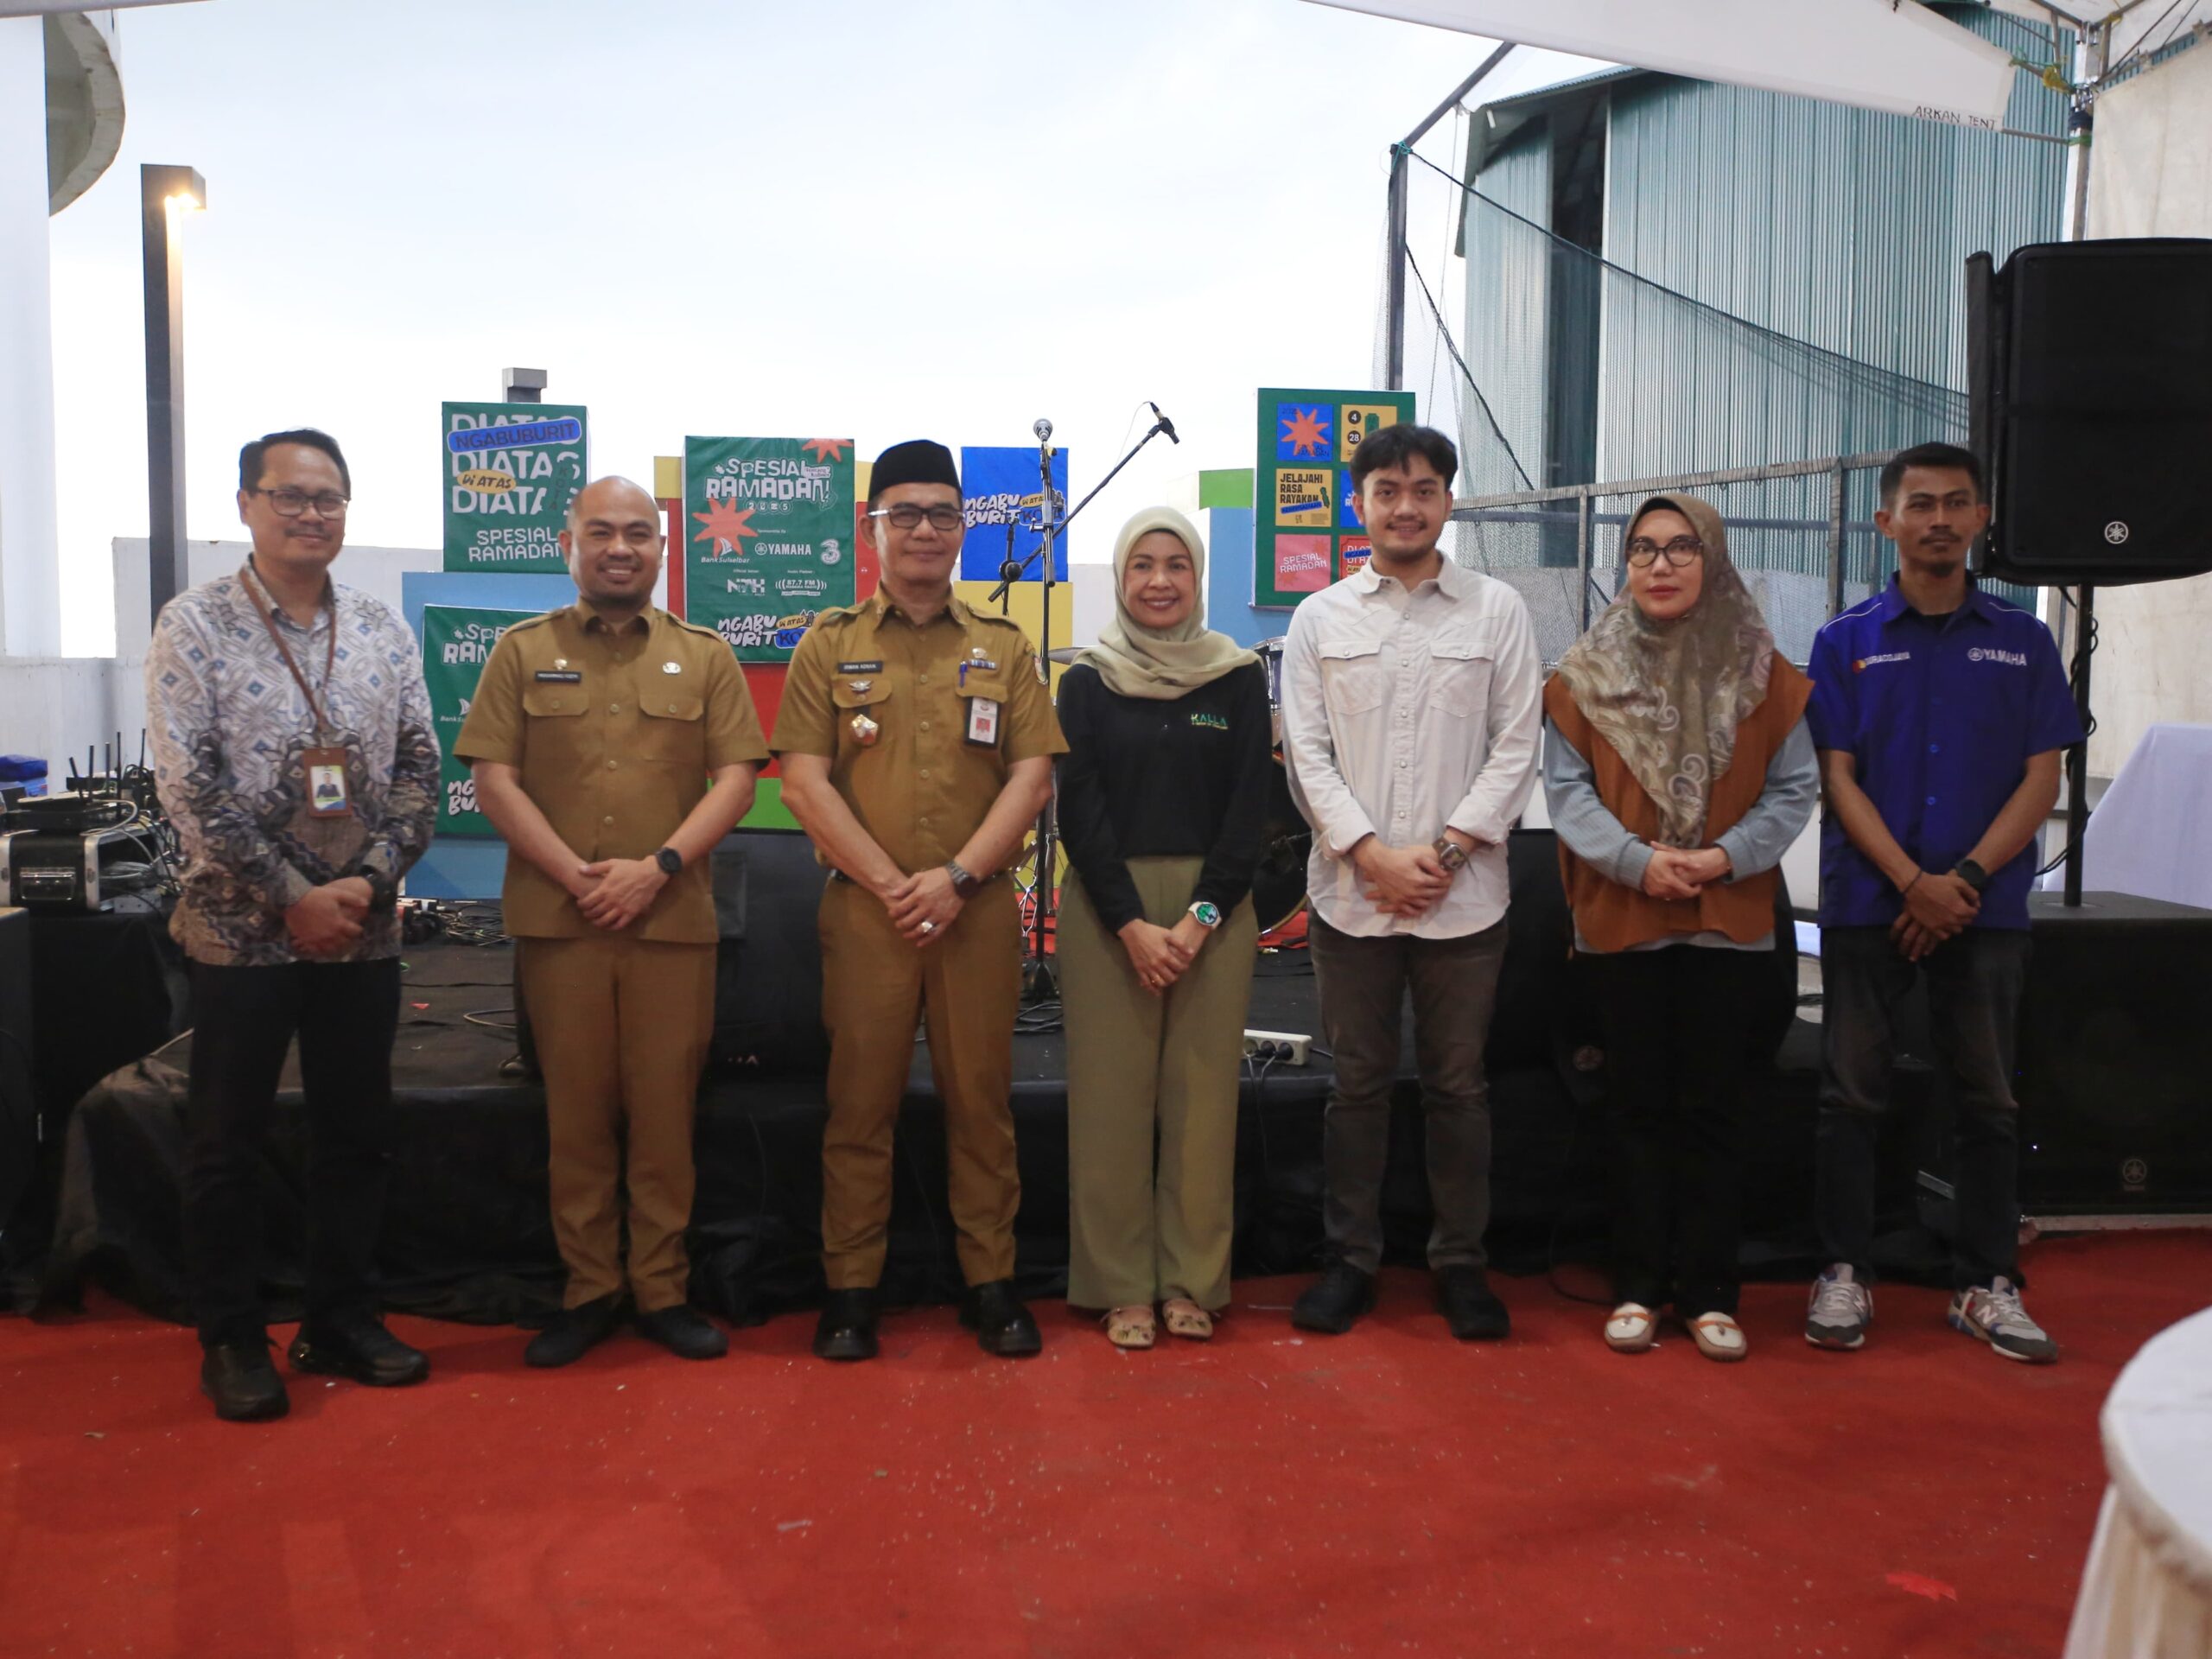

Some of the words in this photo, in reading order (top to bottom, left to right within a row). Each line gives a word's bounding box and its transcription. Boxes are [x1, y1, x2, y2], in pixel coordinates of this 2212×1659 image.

[1912, 105, 1961, 124] ARKAN
[1968, 115, 1997, 130] TENT
[454, 423, 575, 449] NGABUBURIT
[726, 458, 806, 478] SPESIAL
[477, 477, 512, 489] ATAS
[1281, 473, 1323, 483] JELAJAHI
[1281, 484, 1303, 493] RASA
[1281, 494, 1319, 504] RAYAKAN
[476, 526, 558, 545] SPESIAL
[768, 543, 811, 555] YAMAHA
[821, 538, 840, 564] 3
[1283, 552, 1322, 564] SPESIAL
[1280, 559, 1327, 573] RAMADAN
[465, 624, 508, 644] SPE
[1983, 648, 2027, 665] YAMAHA
[1191, 714, 1227, 727] KALLA
